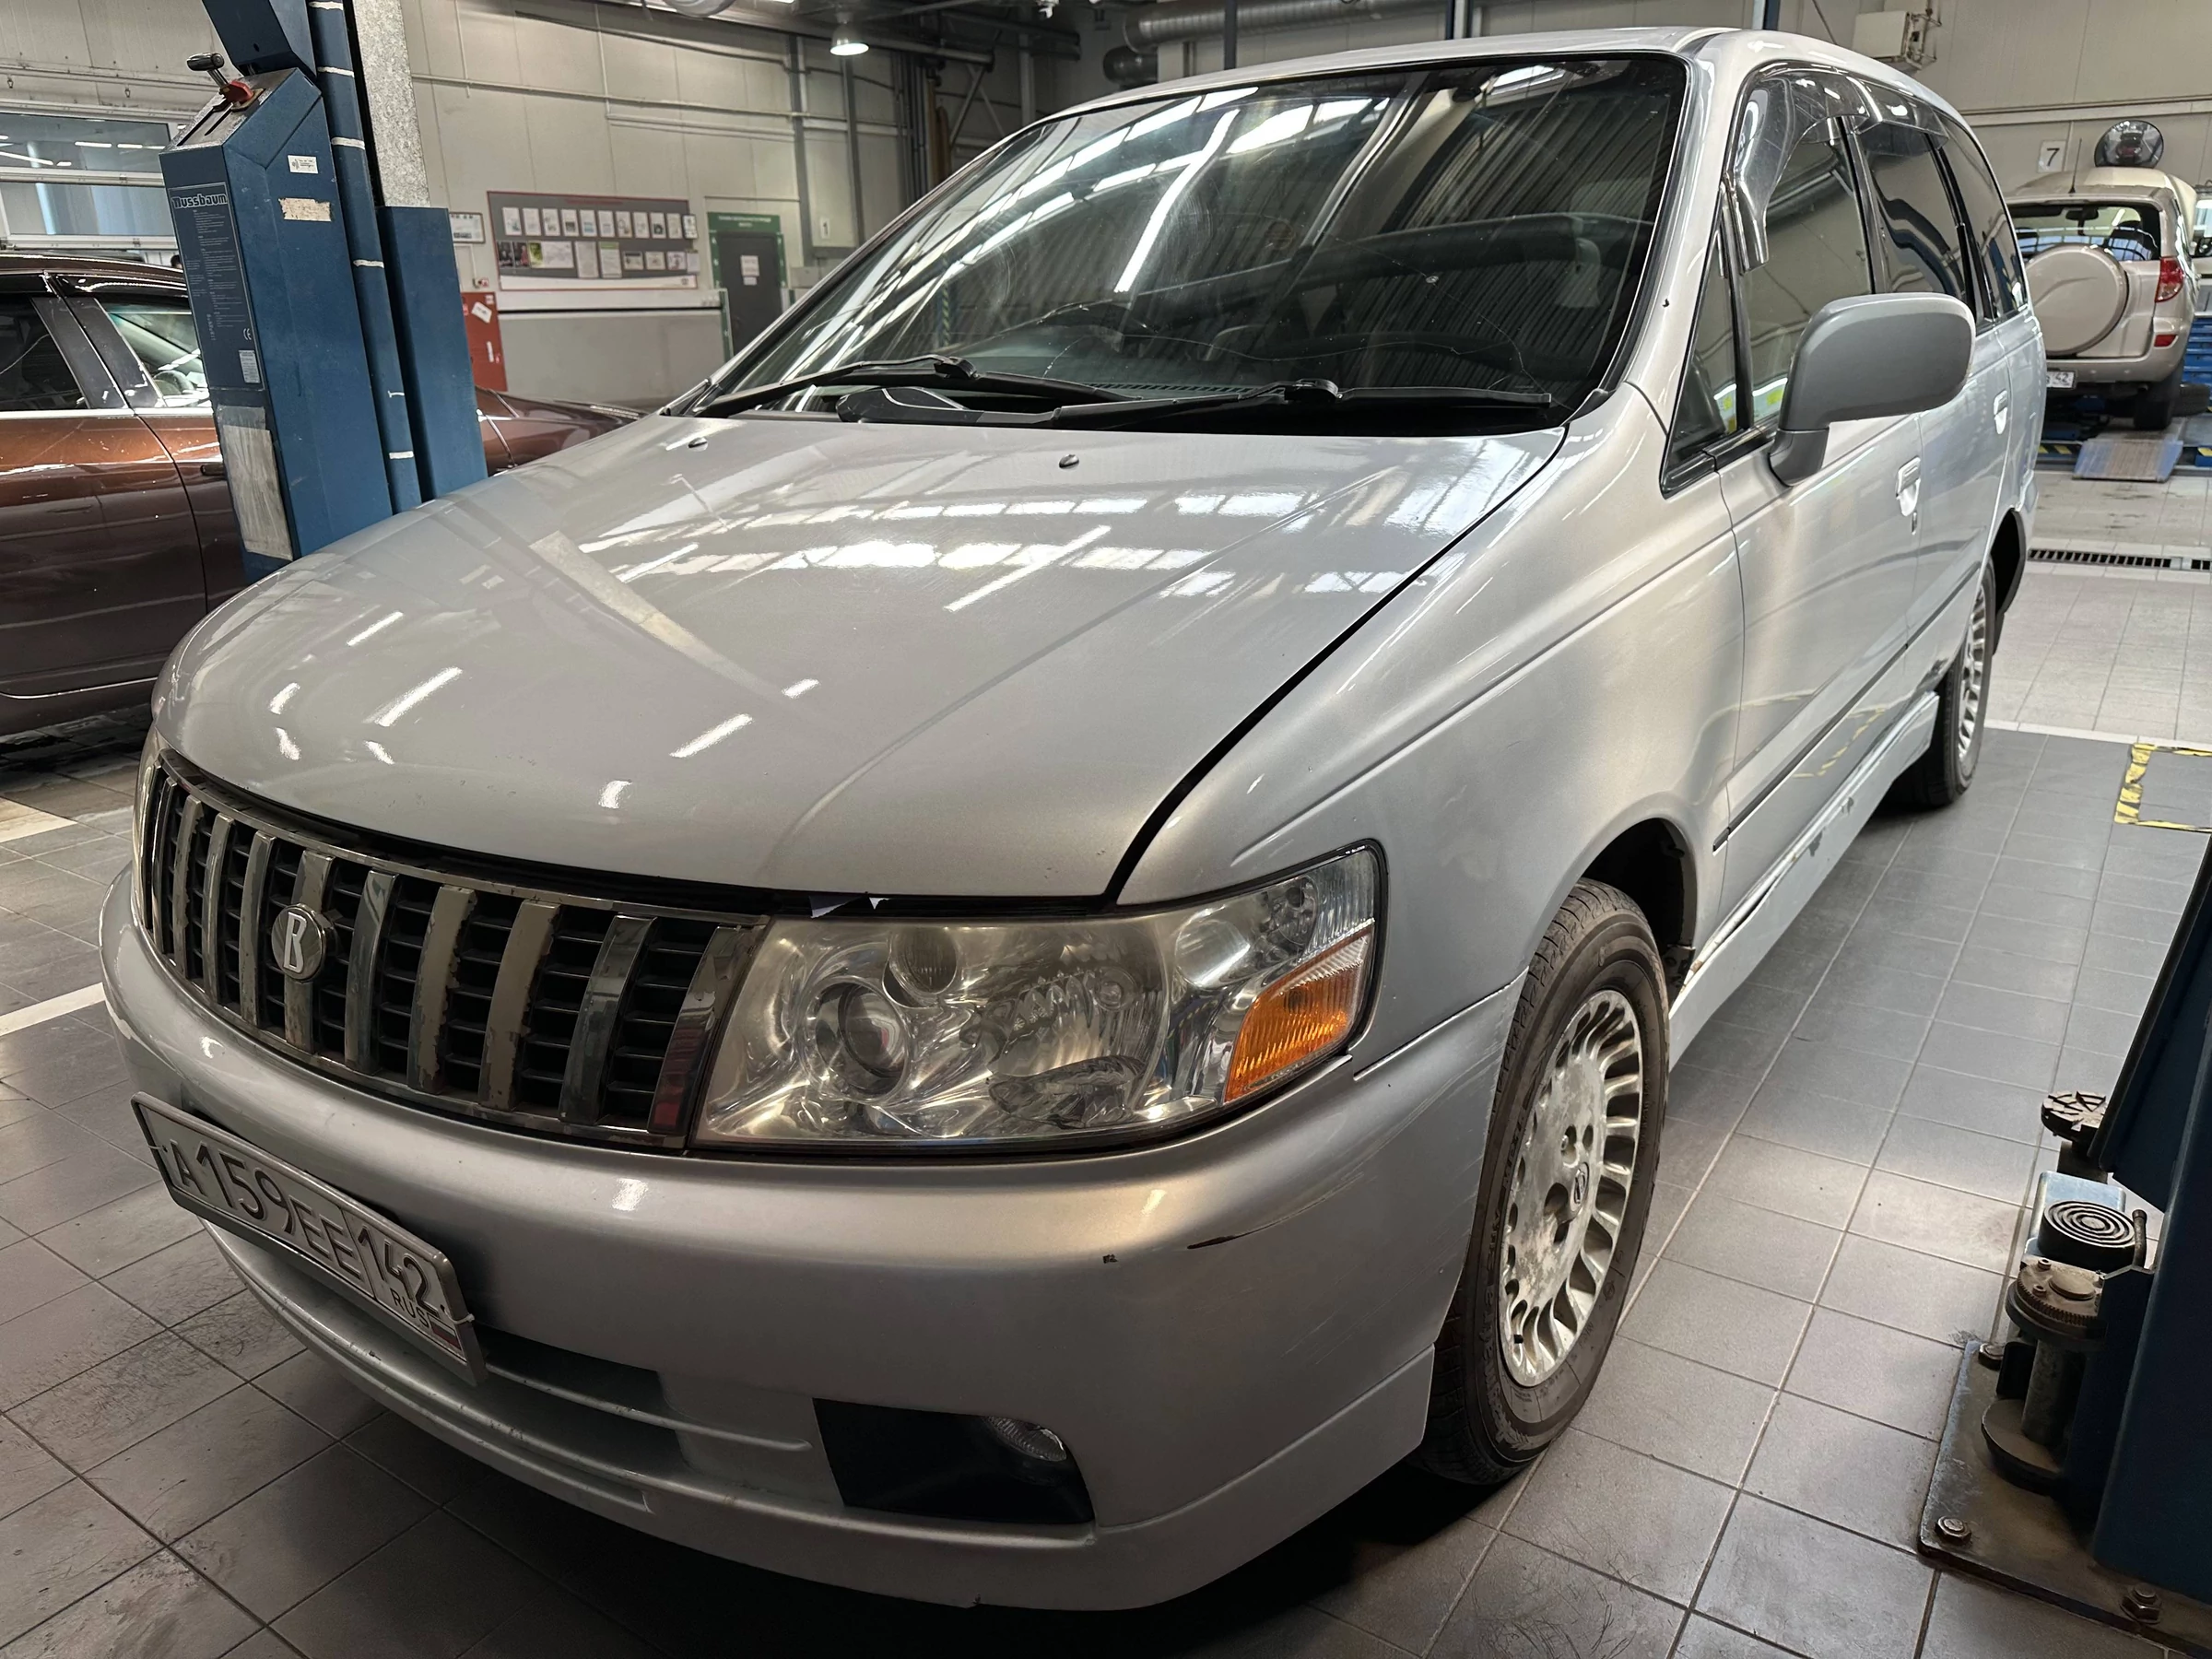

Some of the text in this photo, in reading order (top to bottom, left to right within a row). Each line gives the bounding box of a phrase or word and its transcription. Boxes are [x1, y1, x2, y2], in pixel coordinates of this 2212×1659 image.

[2046, 147, 2060, 167] 7
[171, 193, 228, 208] Nussbaum
[357, 1225, 441, 1319] 142
[390, 1288, 429, 1328] RUS
